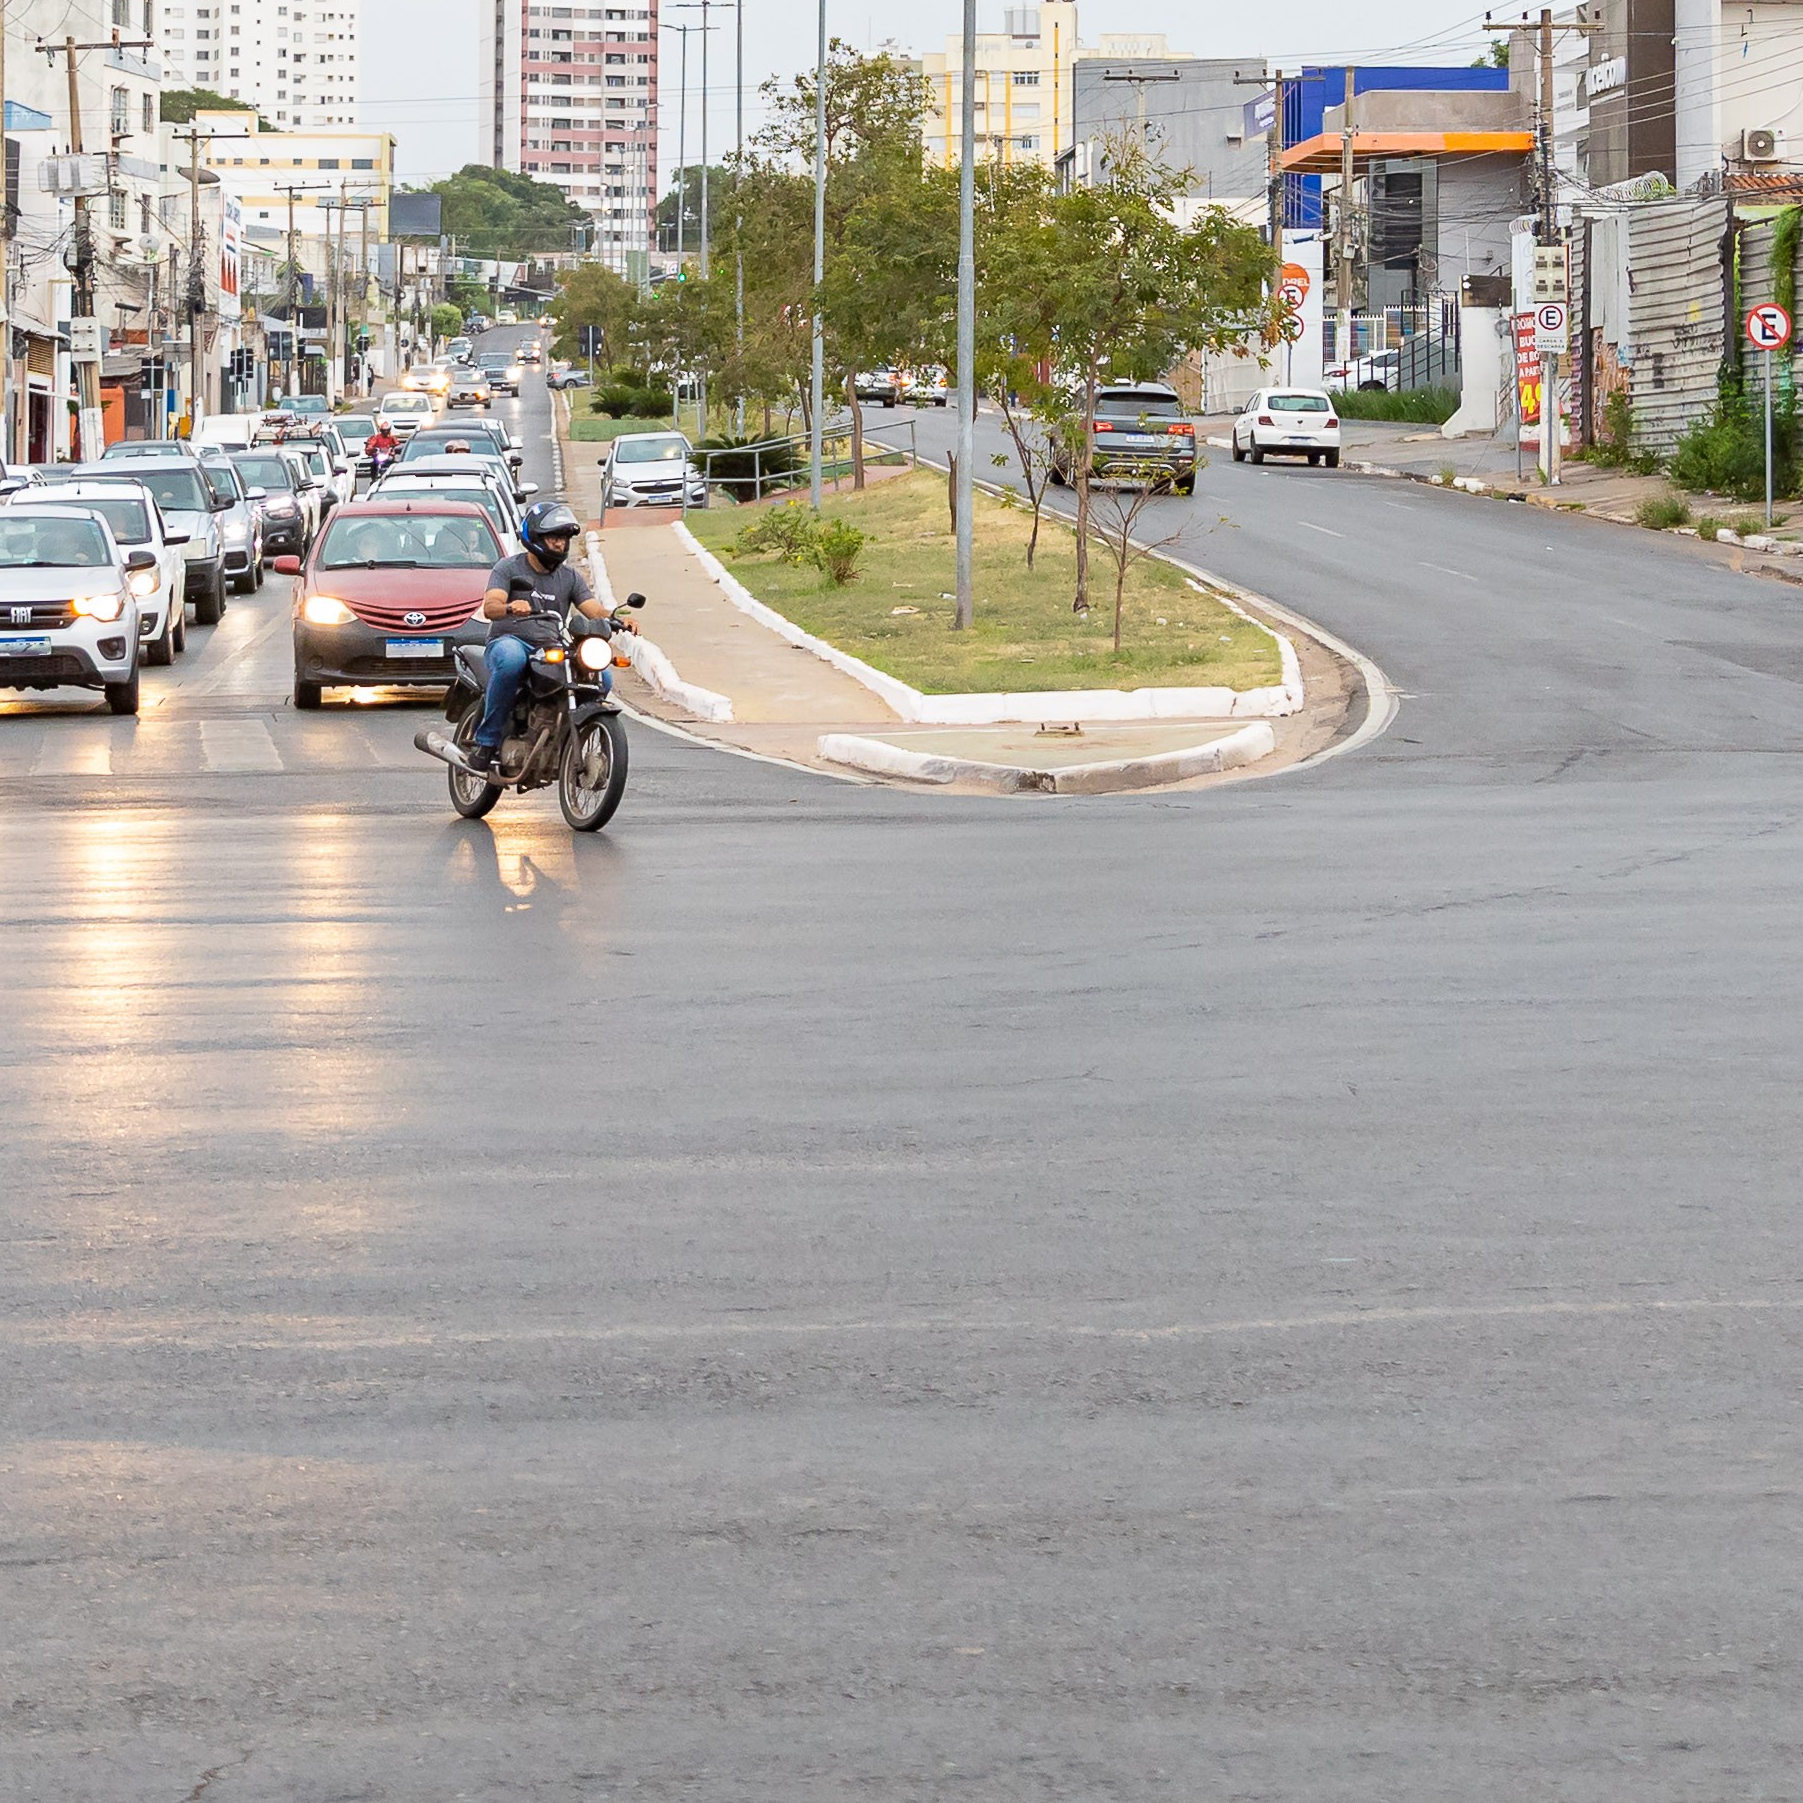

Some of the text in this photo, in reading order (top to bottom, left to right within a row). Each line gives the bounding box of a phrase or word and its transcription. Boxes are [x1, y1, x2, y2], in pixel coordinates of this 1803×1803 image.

[1546, 311, 1557, 326] E
[1761, 313, 1778, 341] E
[10, 606, 33, 624] FIAT
